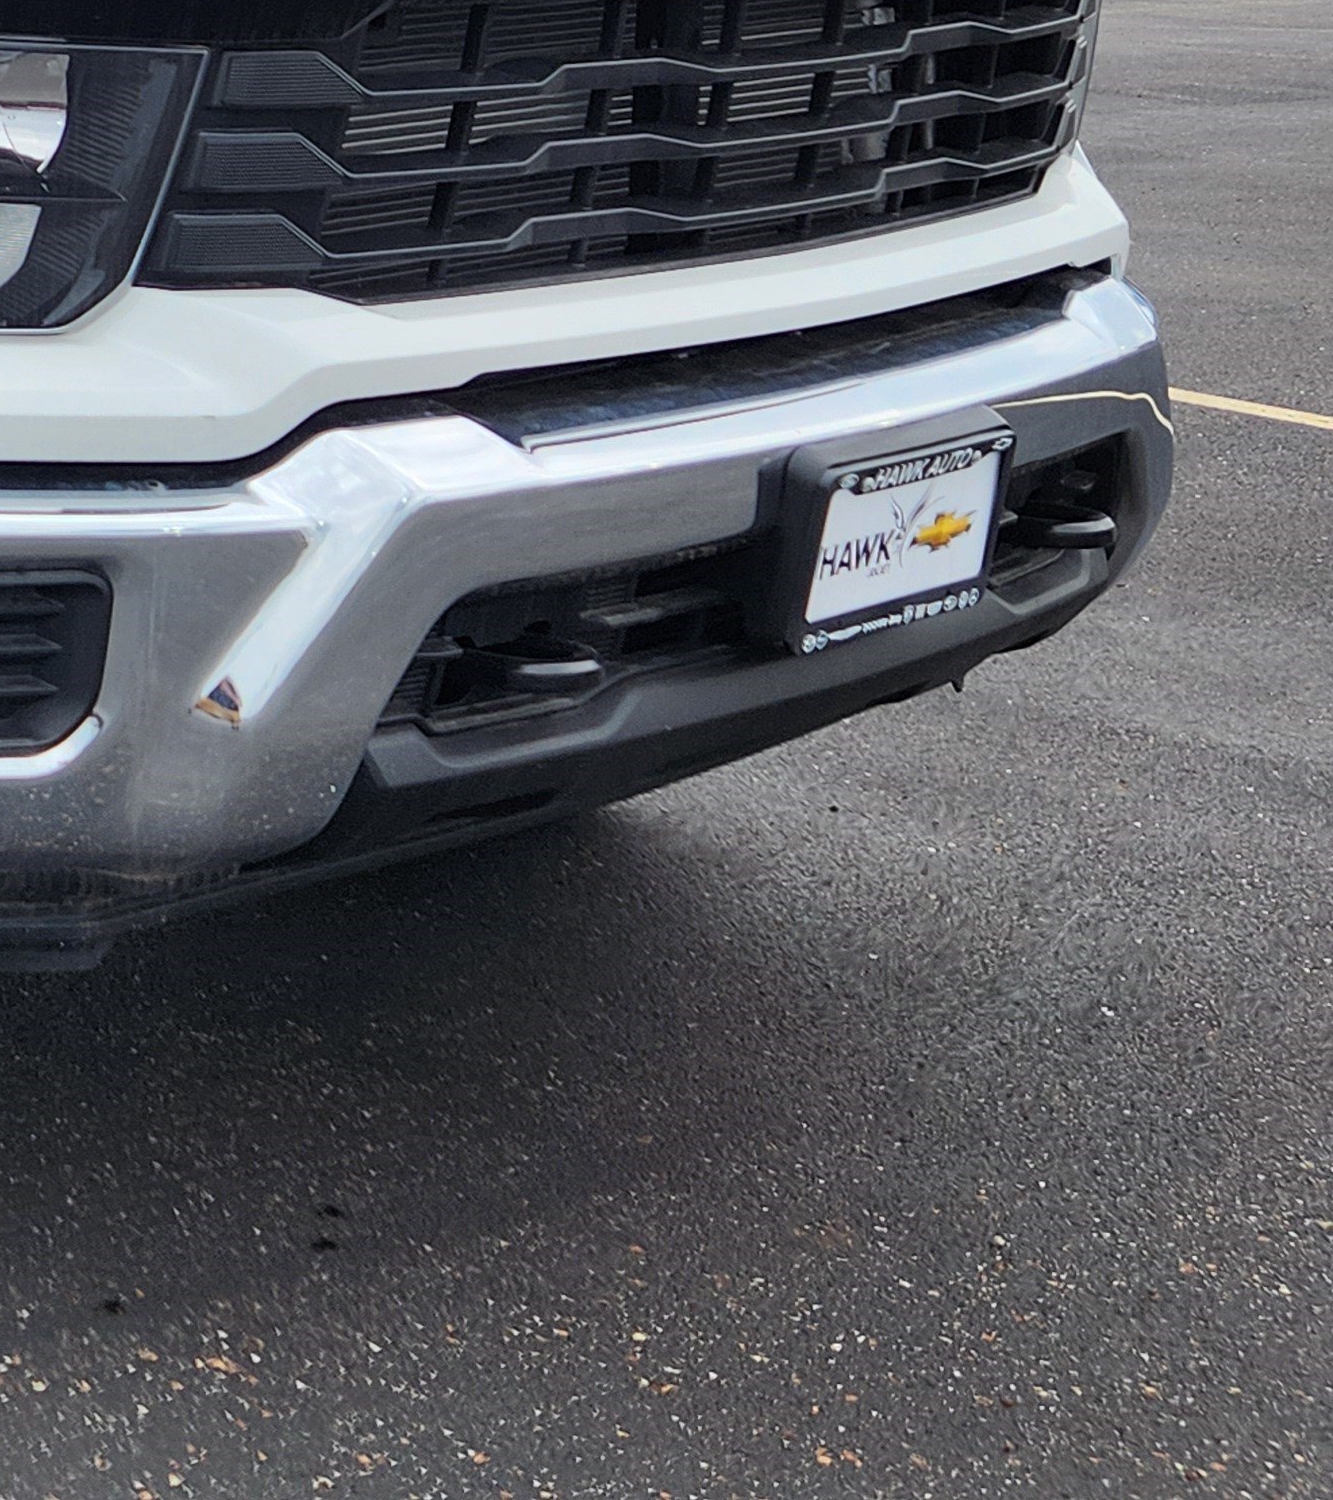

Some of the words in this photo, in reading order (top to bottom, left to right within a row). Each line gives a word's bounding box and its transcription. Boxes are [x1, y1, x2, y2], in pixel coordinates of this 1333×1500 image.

[873, 458, 930, 490] HAWK
[925, 447, 974, 478] AUTO
[819, 529, 895, 581] HAWK
